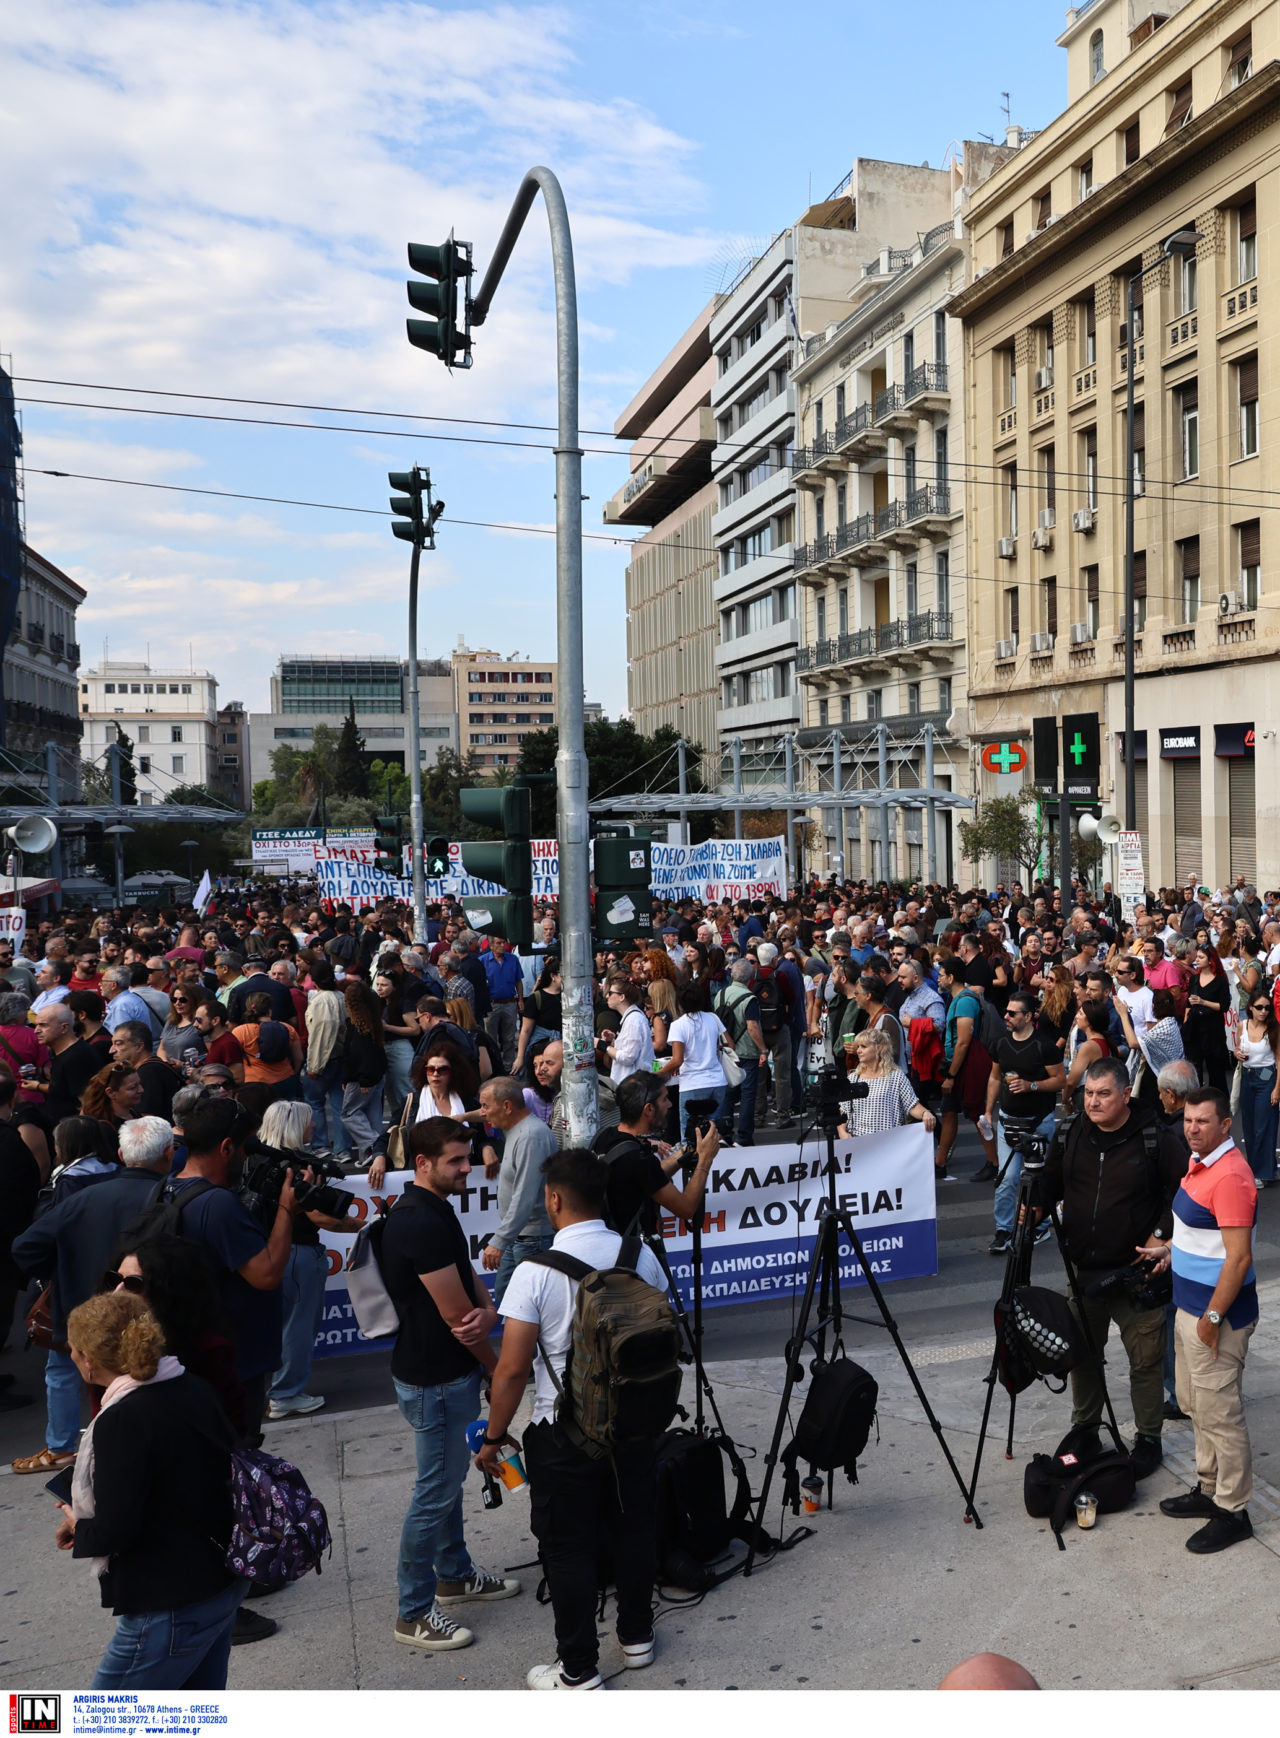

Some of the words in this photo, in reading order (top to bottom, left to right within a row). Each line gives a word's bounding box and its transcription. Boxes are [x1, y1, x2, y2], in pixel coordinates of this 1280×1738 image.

[1164, 736, 1196, 749] EUROBANK
[651, 846, 685, 866] ΟΛΕΙΟ
[713, 863, 725, 880] ΝΑ
[727, 863, 757, 880] ΖΟΥΜΕ
[319, 880, 341, 897] ΚΑΙ
[427, 880, 448, 896] ΜΕ
[706, 884, 719, 900] ΟΧΙ
[722, 882, 742, 901] ΣΤΟ
[704, 1153, 852, 1194] ΚΛΑΒΙΑ!
[710, 1249, 809, 1275] ΔΗΜΟΣΙΩΝ
[690, 1271, 810, 1301] ΚΠΑΙΔΕΥΣΗ
